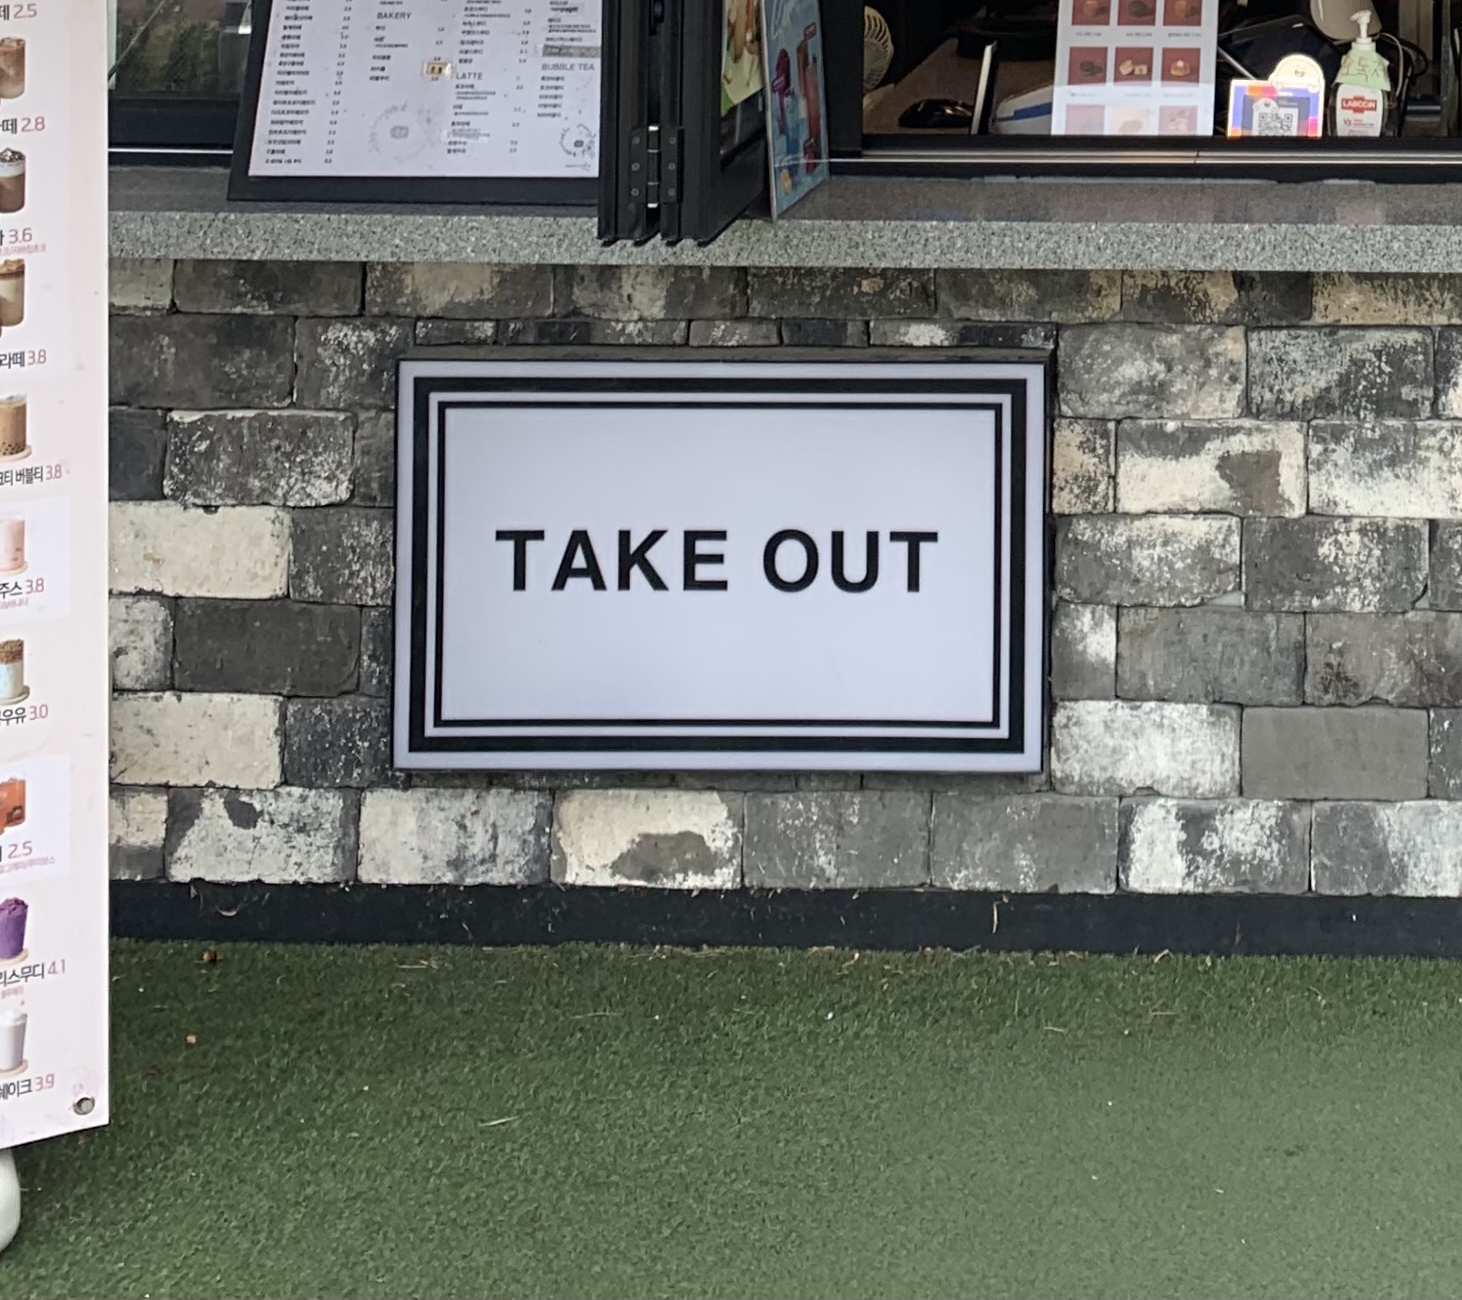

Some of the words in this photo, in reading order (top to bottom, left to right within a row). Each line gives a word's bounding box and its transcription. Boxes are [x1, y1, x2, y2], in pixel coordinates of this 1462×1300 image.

[13, 3, 38, 19] 2.5
[377, 11, 412, 20] BAKERY
[541, 62, 575, 71] BUBBLE
[578, 62, 595, 71] TEA
[455, 72, 483, 80] LATTE
[0, 117, 18, 135] 떼
[20, 116, 46, 133] 2.8
[8, 227, 33, 244] 3.6
[27, 348, 47, 366] 3.8
[15, 466, 44, 485] 버블티
[46, 463, 62, 481] 3.8
[495, 529, 729, 592] TAKE
[763, 528, 939, 593] OUT
[25, 577, 45, 595] 3.8
[0, 706, 27, 726] 우유
[29, 703, 49, 721] 3.0
[8, 840, 33, 859] 2.5
[47, 958, 67, 976] 4.1
[35, 1073, 56, 1093] 3.9
